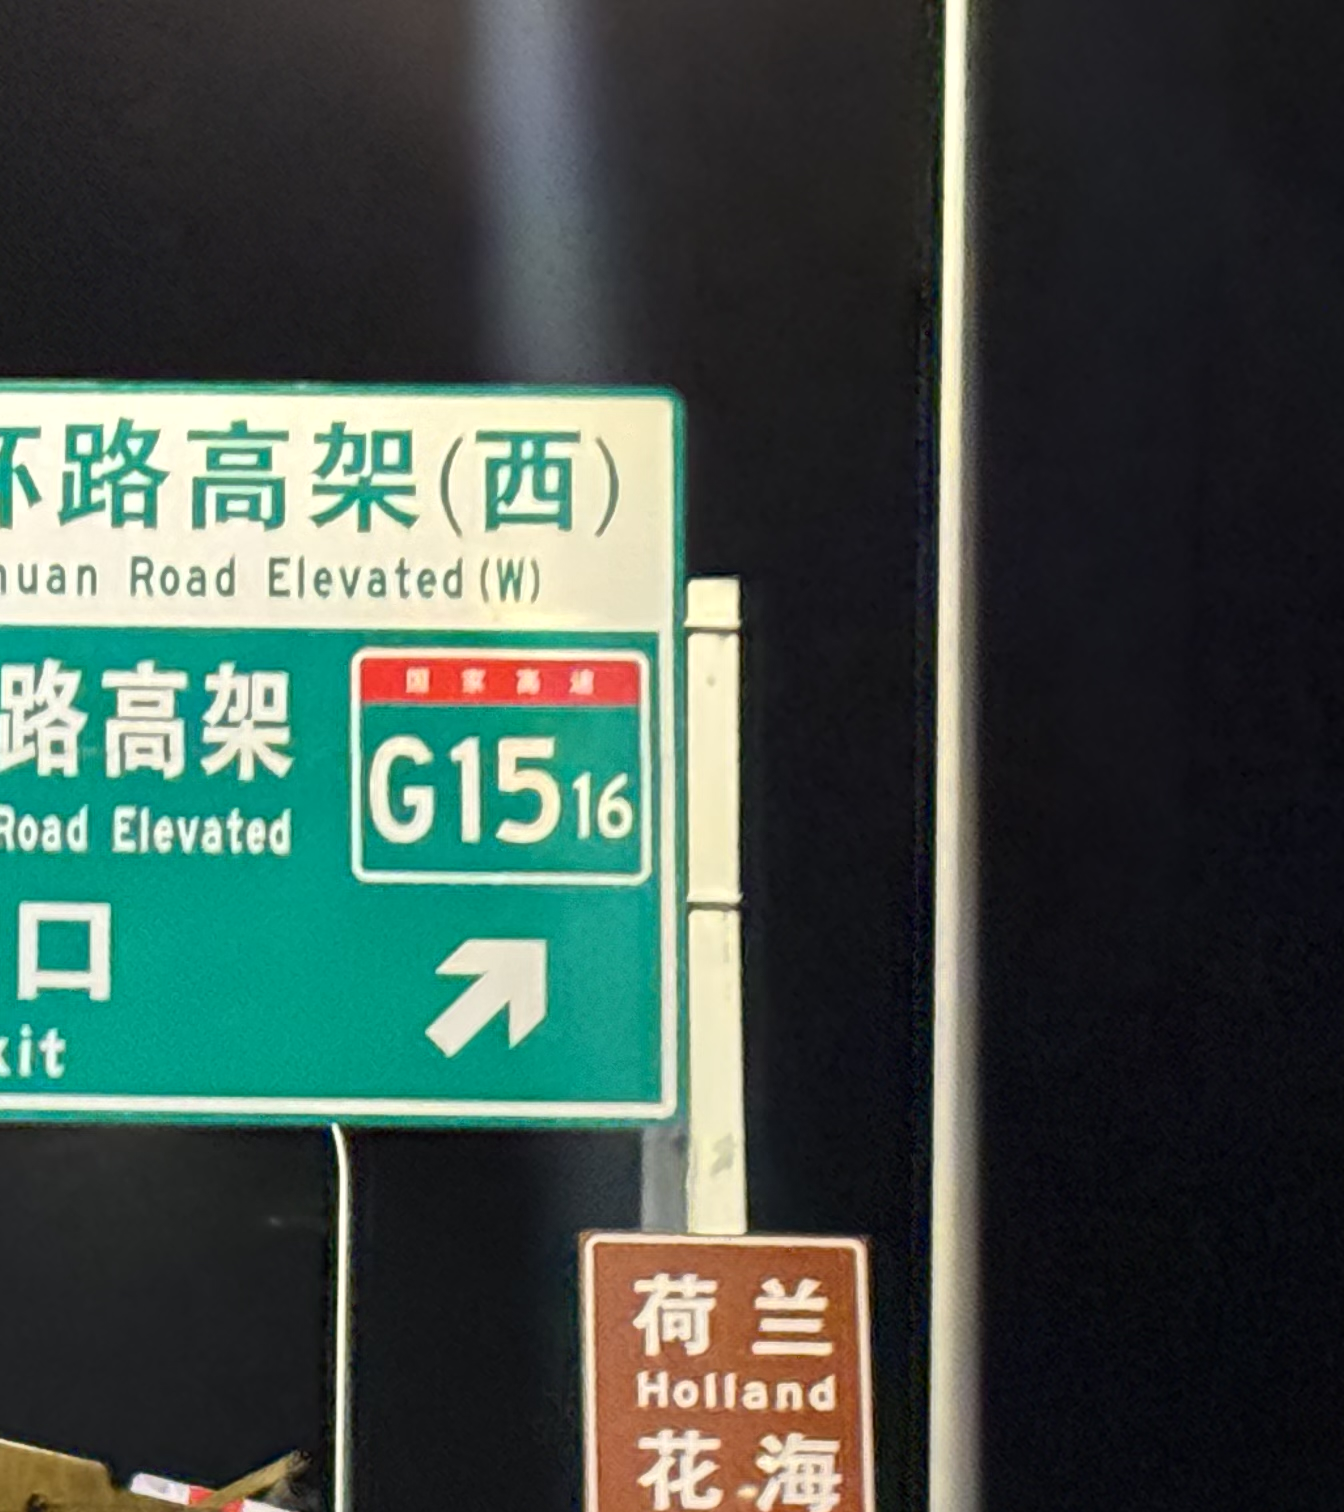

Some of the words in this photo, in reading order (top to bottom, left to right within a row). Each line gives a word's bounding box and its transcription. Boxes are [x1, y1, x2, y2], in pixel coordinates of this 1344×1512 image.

[128, 555, 237, 599] Road
[112, 804, 292, 857] Elevated
[632, 1273, 833, 1356] 荷兰
[637, 1371, 837, 1412] Holland
